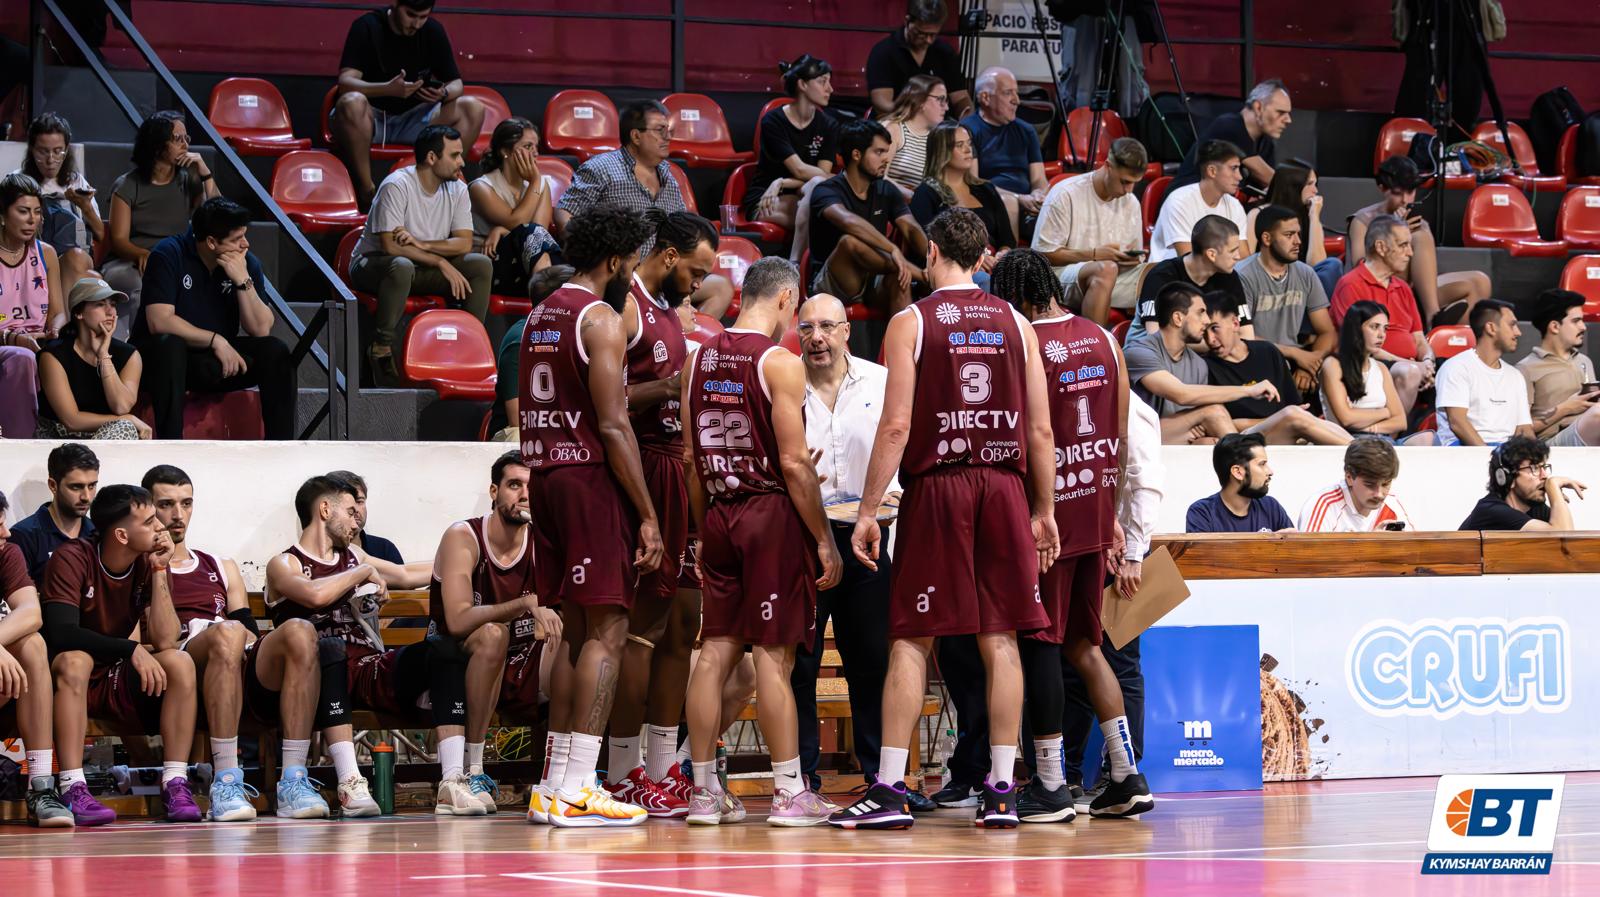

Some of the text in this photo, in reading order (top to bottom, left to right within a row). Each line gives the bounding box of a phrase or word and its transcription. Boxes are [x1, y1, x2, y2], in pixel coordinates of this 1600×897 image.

[986, 13, 1026, 29] PACIO
[1002, 39, 1039, 54] PARA
[12, 305, 31, 320] 21
[964, 305, 1003, 314] ESPAÑOLA
[949, 329, 1004, 345] 40 AÑOS
[1068, 337, 1100, 349] ESPAÑOLA
[719, 354, 752, 363] ESPAÑOLA
[1071, 347, 1092, 356] MOVIL
[530, 362, 556, 404] 0
[960, 361, 992, 405] 3
[1060, 370, 1075, 383] 40
[704, 380, 720, 392] 40
[936, 410, 1019, 434] DIRECTV
[1077, 395, 1096, 436] 1
[697, 409, 754, 450] 22
[550, 447, 590, 462] OBAO
[980, 447, 1021, 462] OBAO
[1054, 486, 1096, 502] Securitas
[1351, 623, 1566, 713] CRUFI
[1173, 755, 1224, 766] mercado
[1179, 749, 1214, 758] macro
